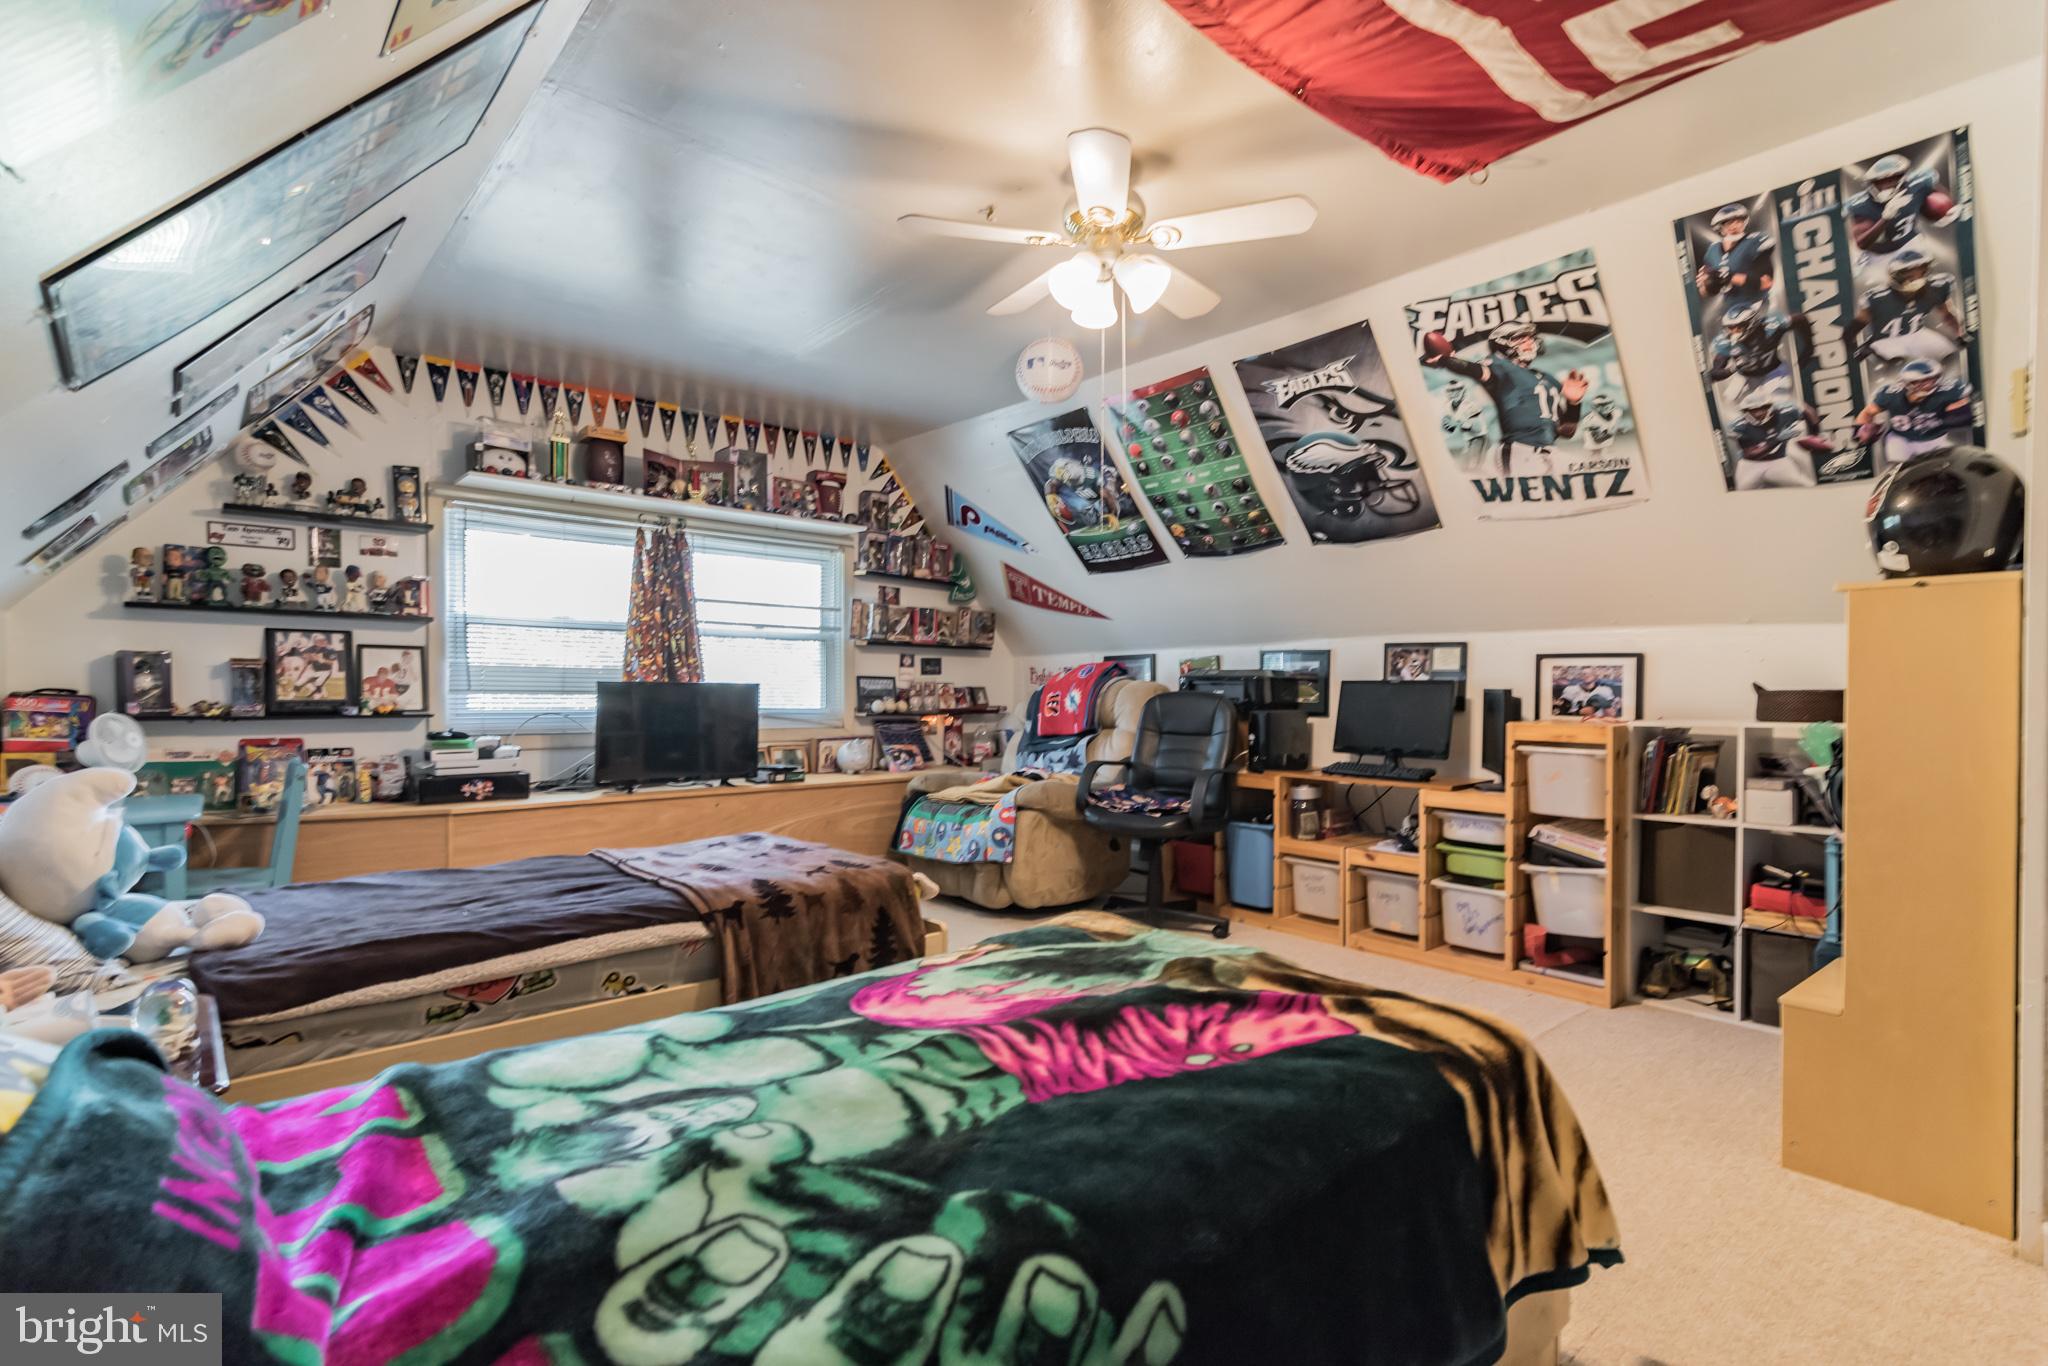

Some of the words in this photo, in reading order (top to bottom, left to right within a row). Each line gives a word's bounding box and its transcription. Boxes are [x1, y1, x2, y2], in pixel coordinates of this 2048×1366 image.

[1408, 266, 1611, 346] EAGLES
[1792, 215, 1858, 452] CHAMPIONS
[1261, 356, 1356, 405] EAGLES
[1472, 469, 1634, 503] WENTZ
